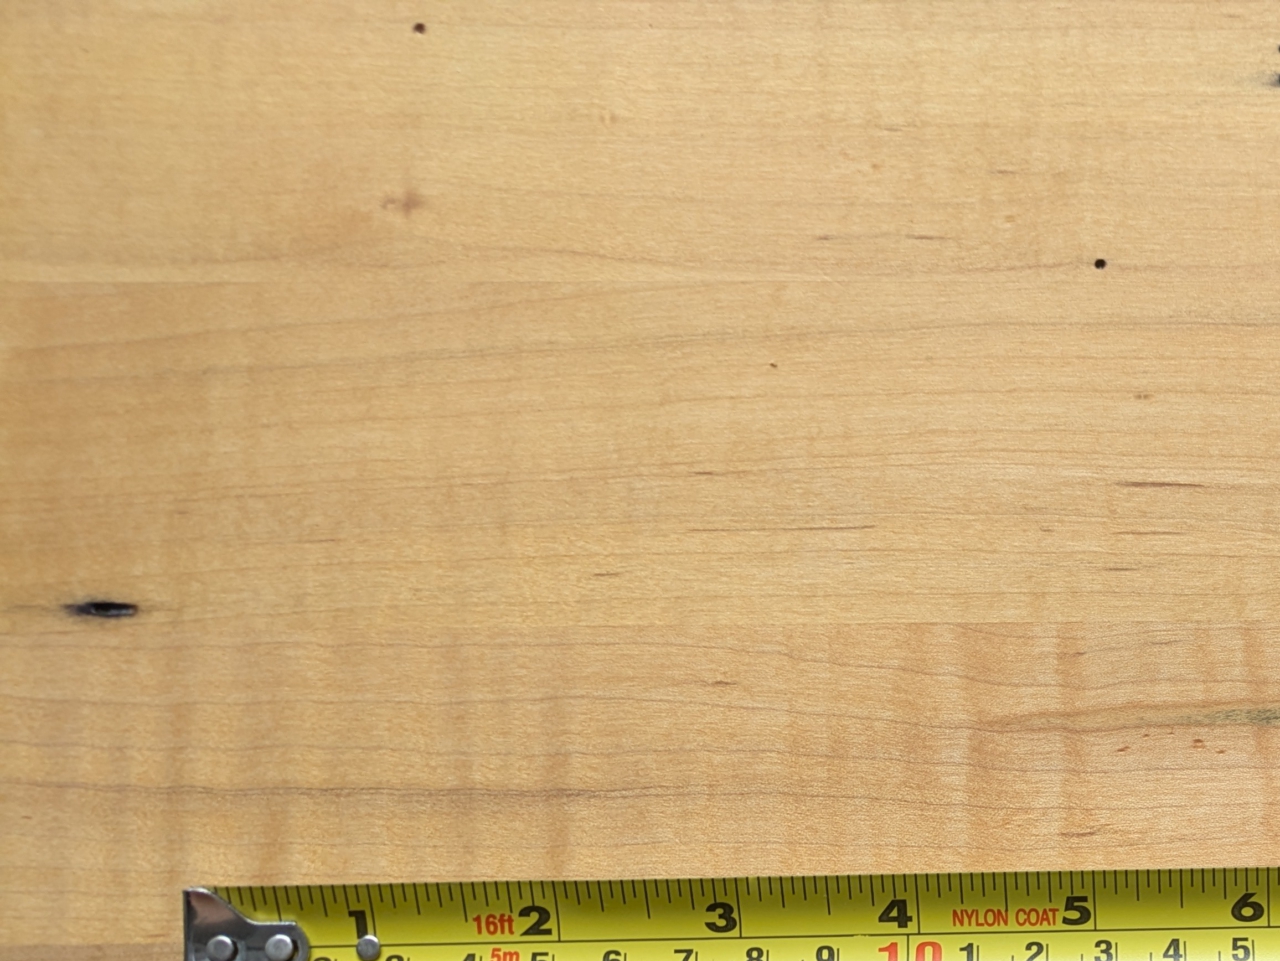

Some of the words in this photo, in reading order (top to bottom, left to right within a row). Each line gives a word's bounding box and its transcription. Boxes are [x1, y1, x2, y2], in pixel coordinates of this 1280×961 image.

[348, 909, 369, 939] 1
[518, 905, 552, 936] 2
[704, 902, 738, 933] 3
[878, 899, 912, 928] 4
[1061, 896, 1091, 925] 5
[1230, 893, 1264, 922] 6
[472, 914, 515, 936] 16ft
[952, 909, 1008, 927] NYLON
[1015, 908, 1059, 926] COAT
[1231, 938, 1251, 961] 5
